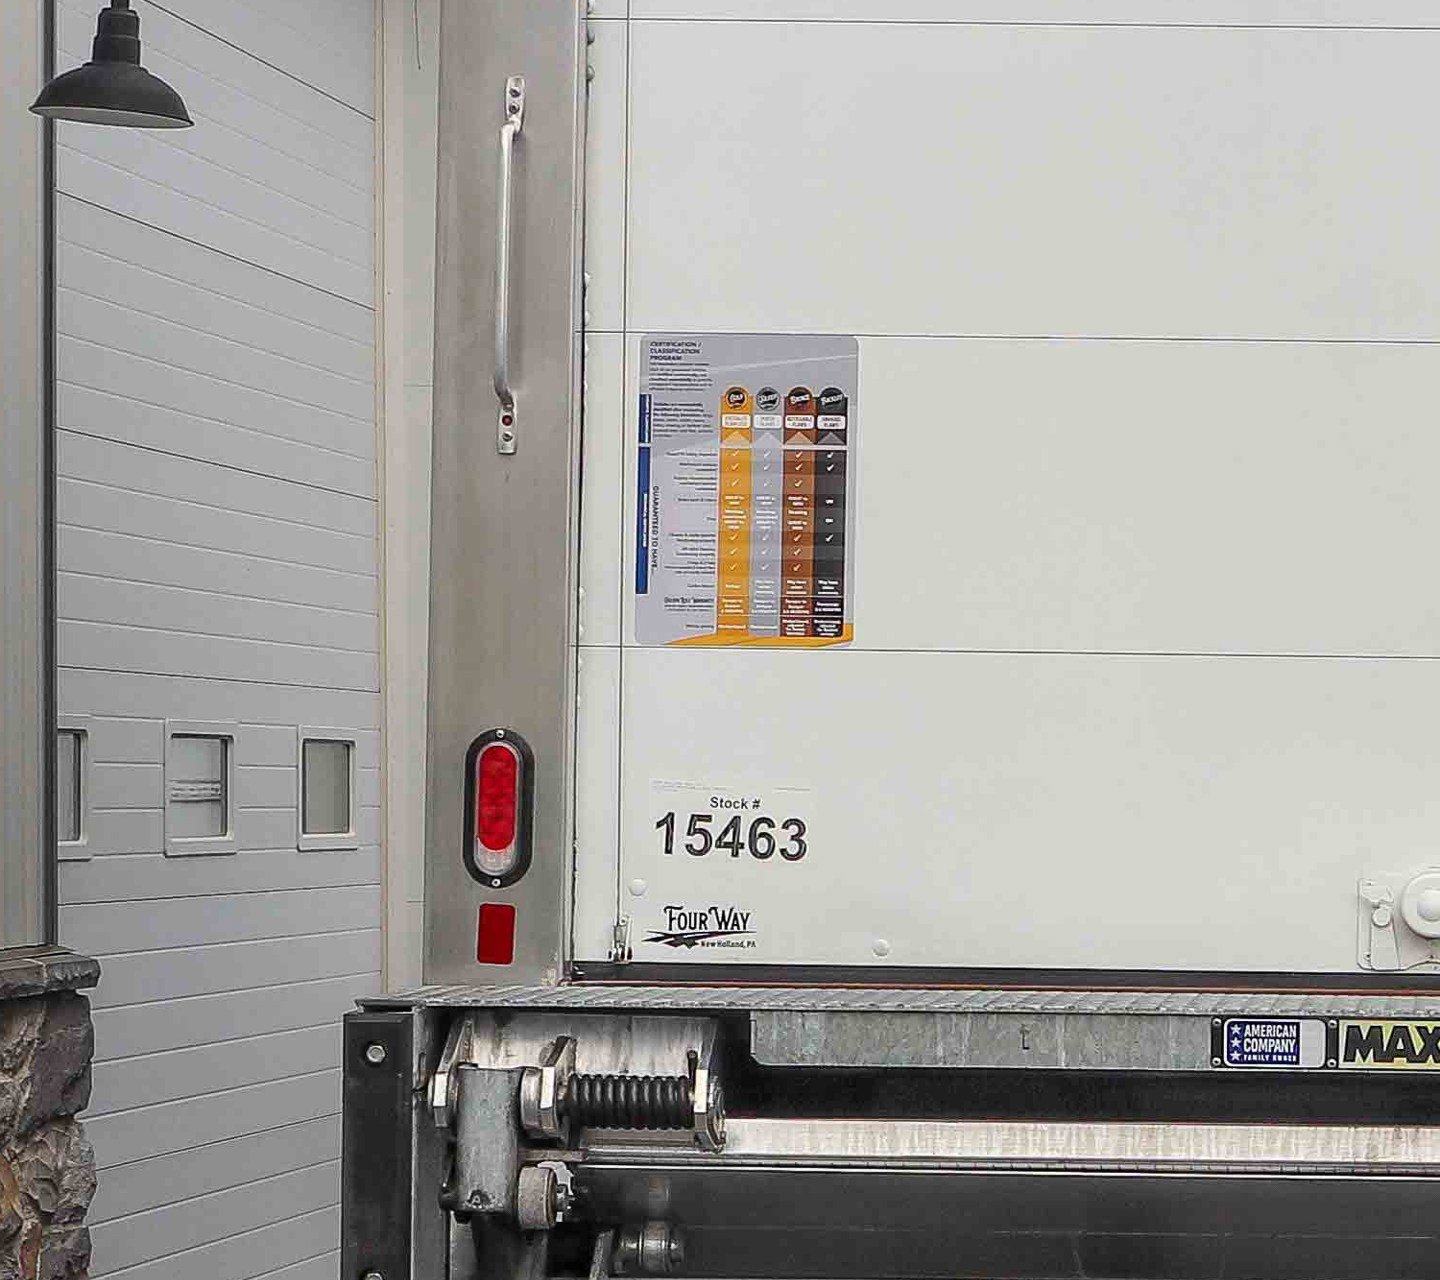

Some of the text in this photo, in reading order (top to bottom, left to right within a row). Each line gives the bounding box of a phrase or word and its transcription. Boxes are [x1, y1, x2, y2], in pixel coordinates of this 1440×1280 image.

[710, 796, 761, 810] Stock #
[655, 811, 808, 862] 15463
[747, 940, 757, 948] PA
[1244, 1024, 1297, 1038] AMERICAN
[1243, 1038, 1296, 1053] COMPANY
